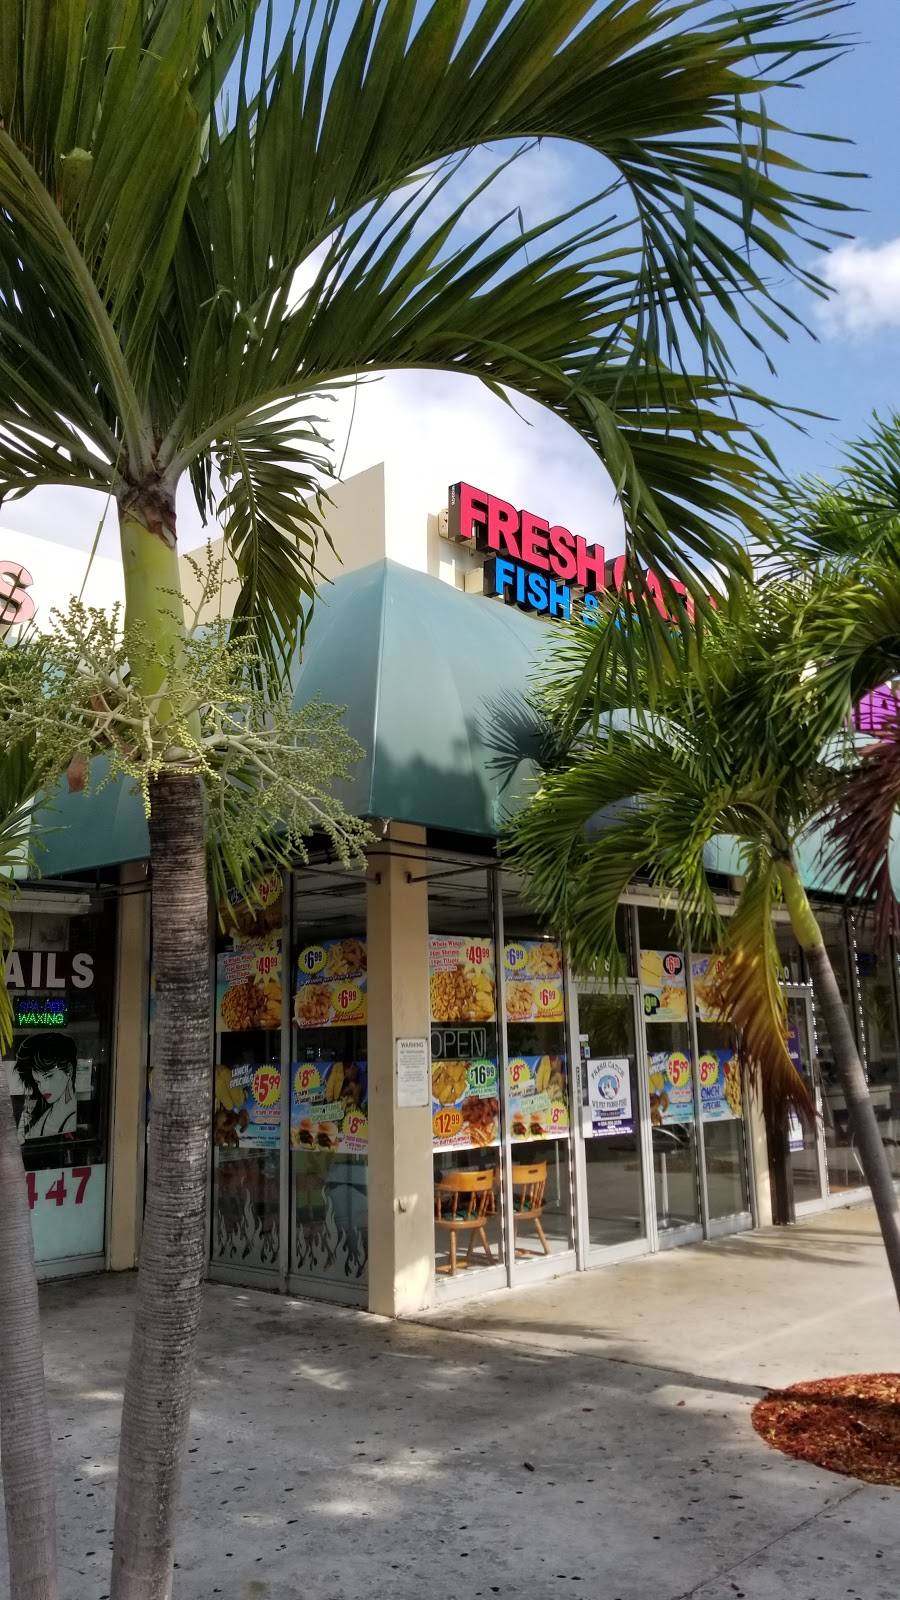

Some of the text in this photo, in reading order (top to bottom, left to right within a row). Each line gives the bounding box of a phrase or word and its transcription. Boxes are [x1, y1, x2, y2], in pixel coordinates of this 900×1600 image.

[459, 481, 605, 587] FRESH
[495, 556, 571, 621] FISH
[19, 1012, 64, 1025] WAXING
[401, 1041, 424, 1049] WARNING
[431, 1031, 484, 1059] OPEN
